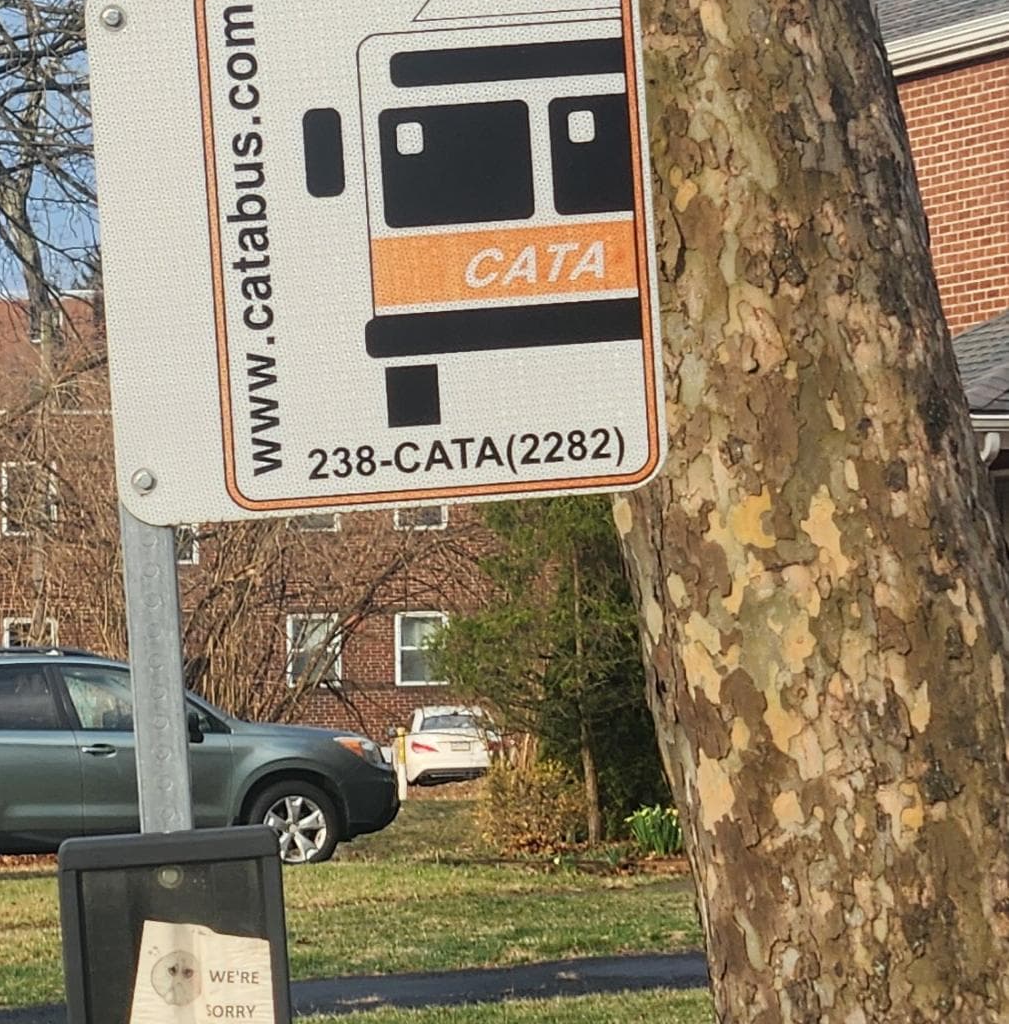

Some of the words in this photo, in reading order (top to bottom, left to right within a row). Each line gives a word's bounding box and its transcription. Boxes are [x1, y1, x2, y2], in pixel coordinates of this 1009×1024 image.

[223, 3, 283, 475] www.catabus.com
[464, 240, 606, 288] CATA
[307, 427, 626, 480] 238-CATA(2282)
[210, 970, 259, 984] WE'RE
[207, 1005, 256, 1018] SORRY
